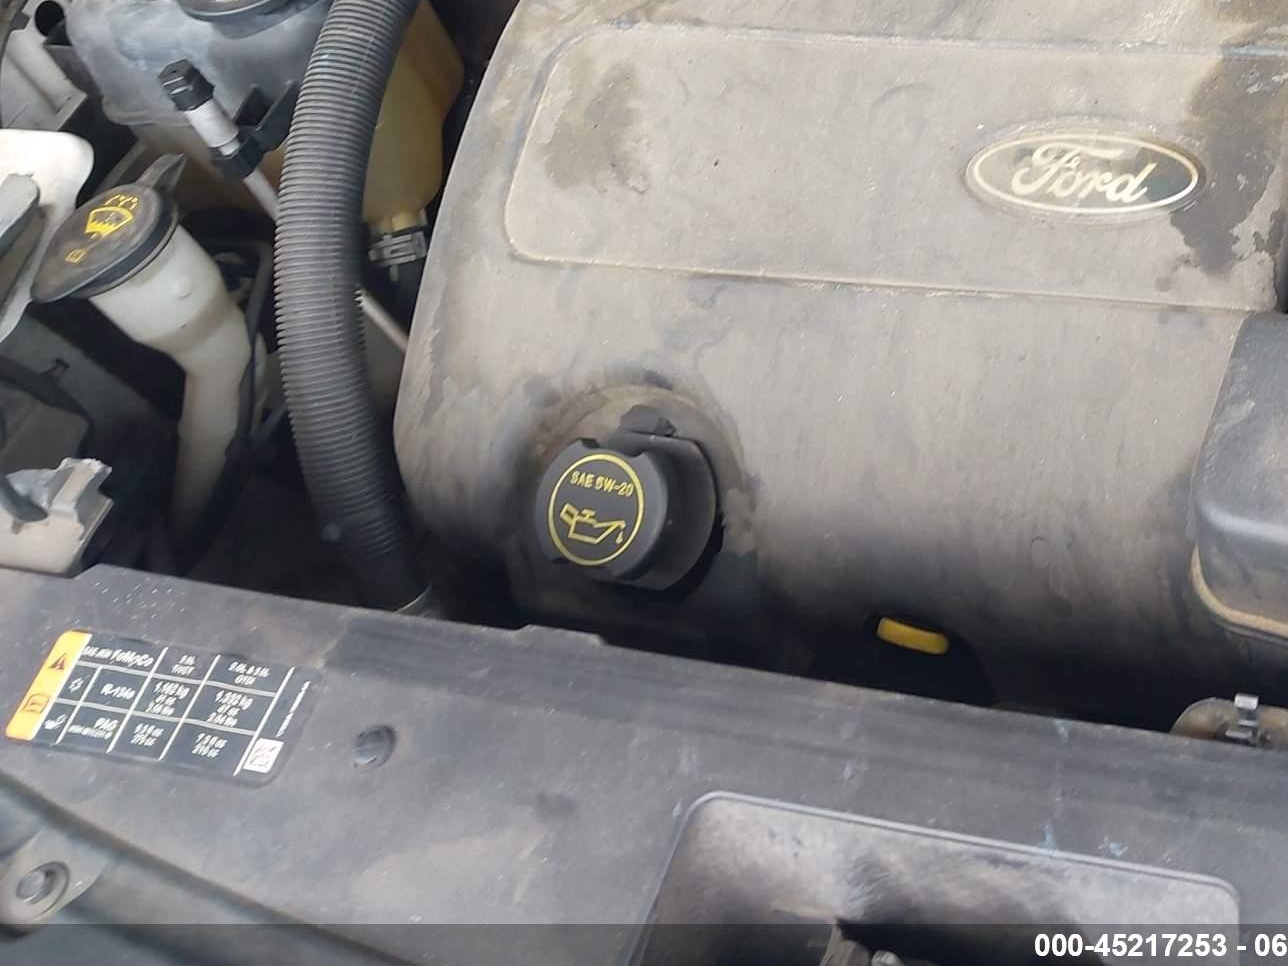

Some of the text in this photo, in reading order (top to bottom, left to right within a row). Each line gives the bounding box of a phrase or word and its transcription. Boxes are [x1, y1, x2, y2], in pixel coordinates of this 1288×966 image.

[1011, 141, 1157, 203] Ford
[571, 471, 633, 496] SAE 5W-20
